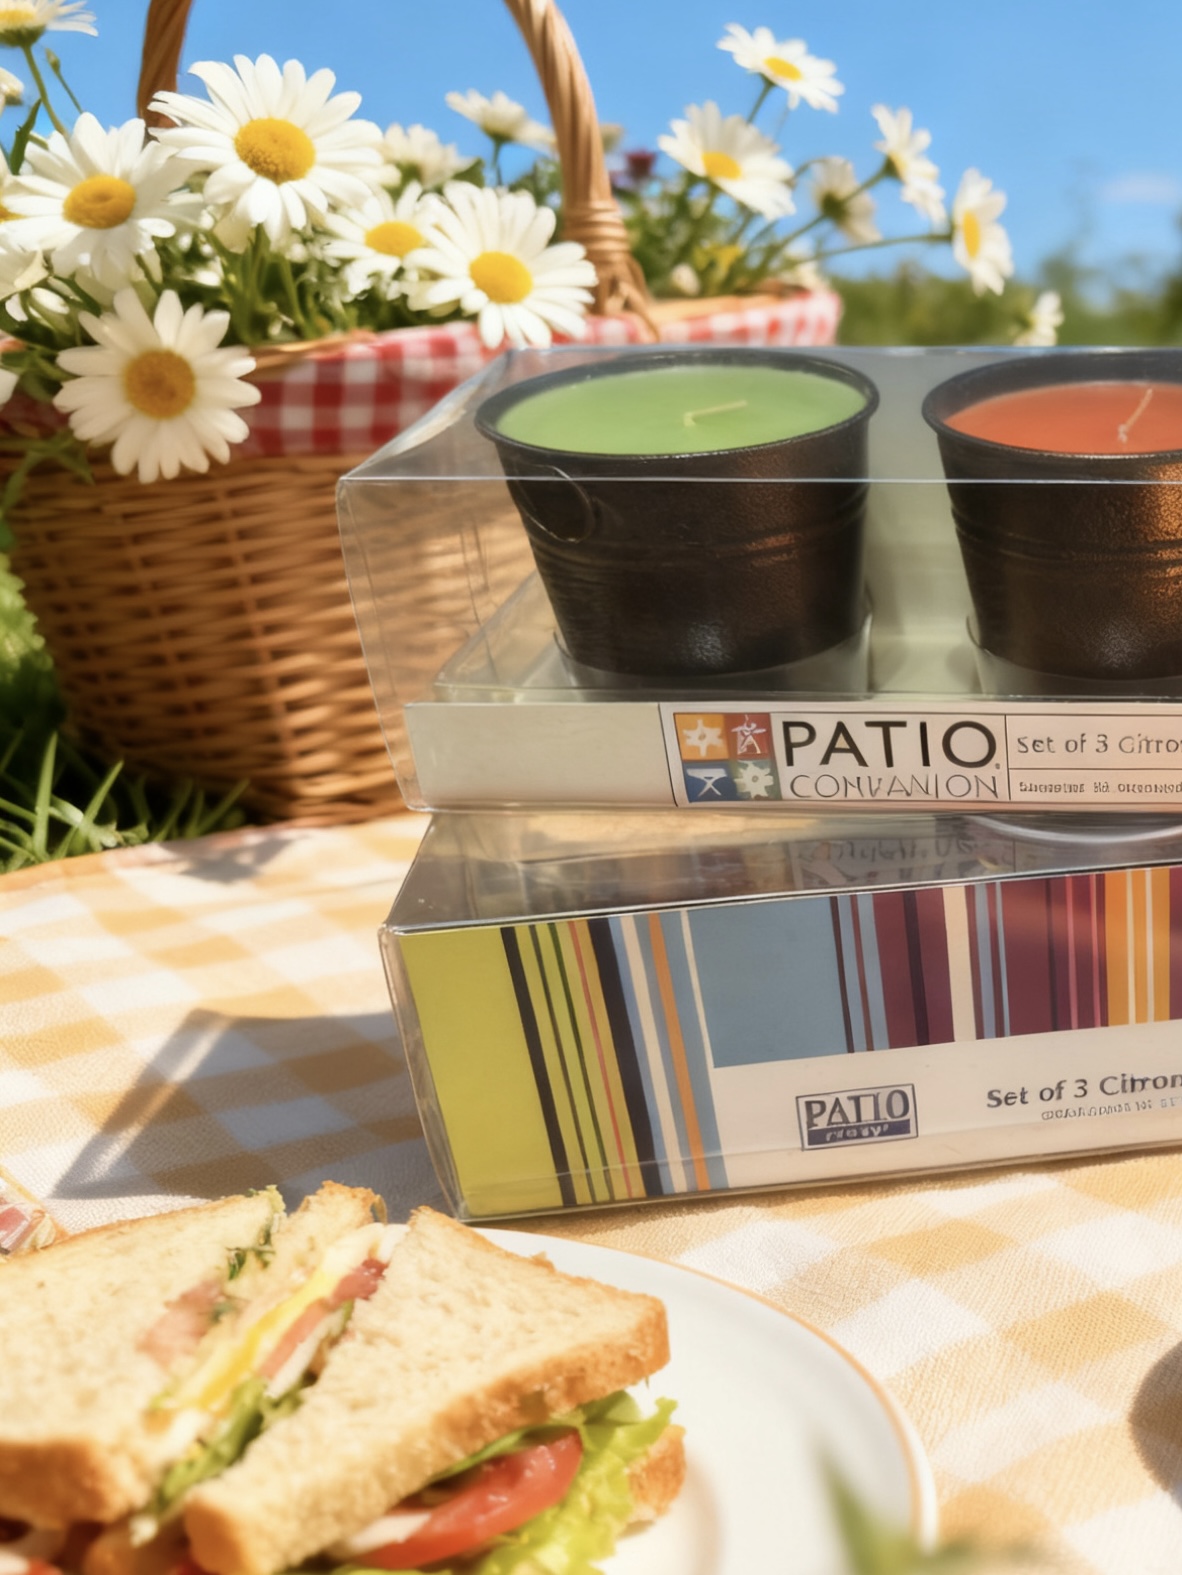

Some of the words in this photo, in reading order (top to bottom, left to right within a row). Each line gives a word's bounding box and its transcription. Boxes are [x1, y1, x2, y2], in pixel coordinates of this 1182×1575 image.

[782, 720, 997, 768] PATIO
[1016, 736, 1056, 754] Set
[1064, 733, 1088, 754] of
[1094, 733, 1109, 754] 3
[804, 1089, 910, 1129] PATIO
[986, 1086, 1029, 1109] Set
[1038, 1079, 1068, 1102] of
[1073, 1078, 1088, 1098] 3
